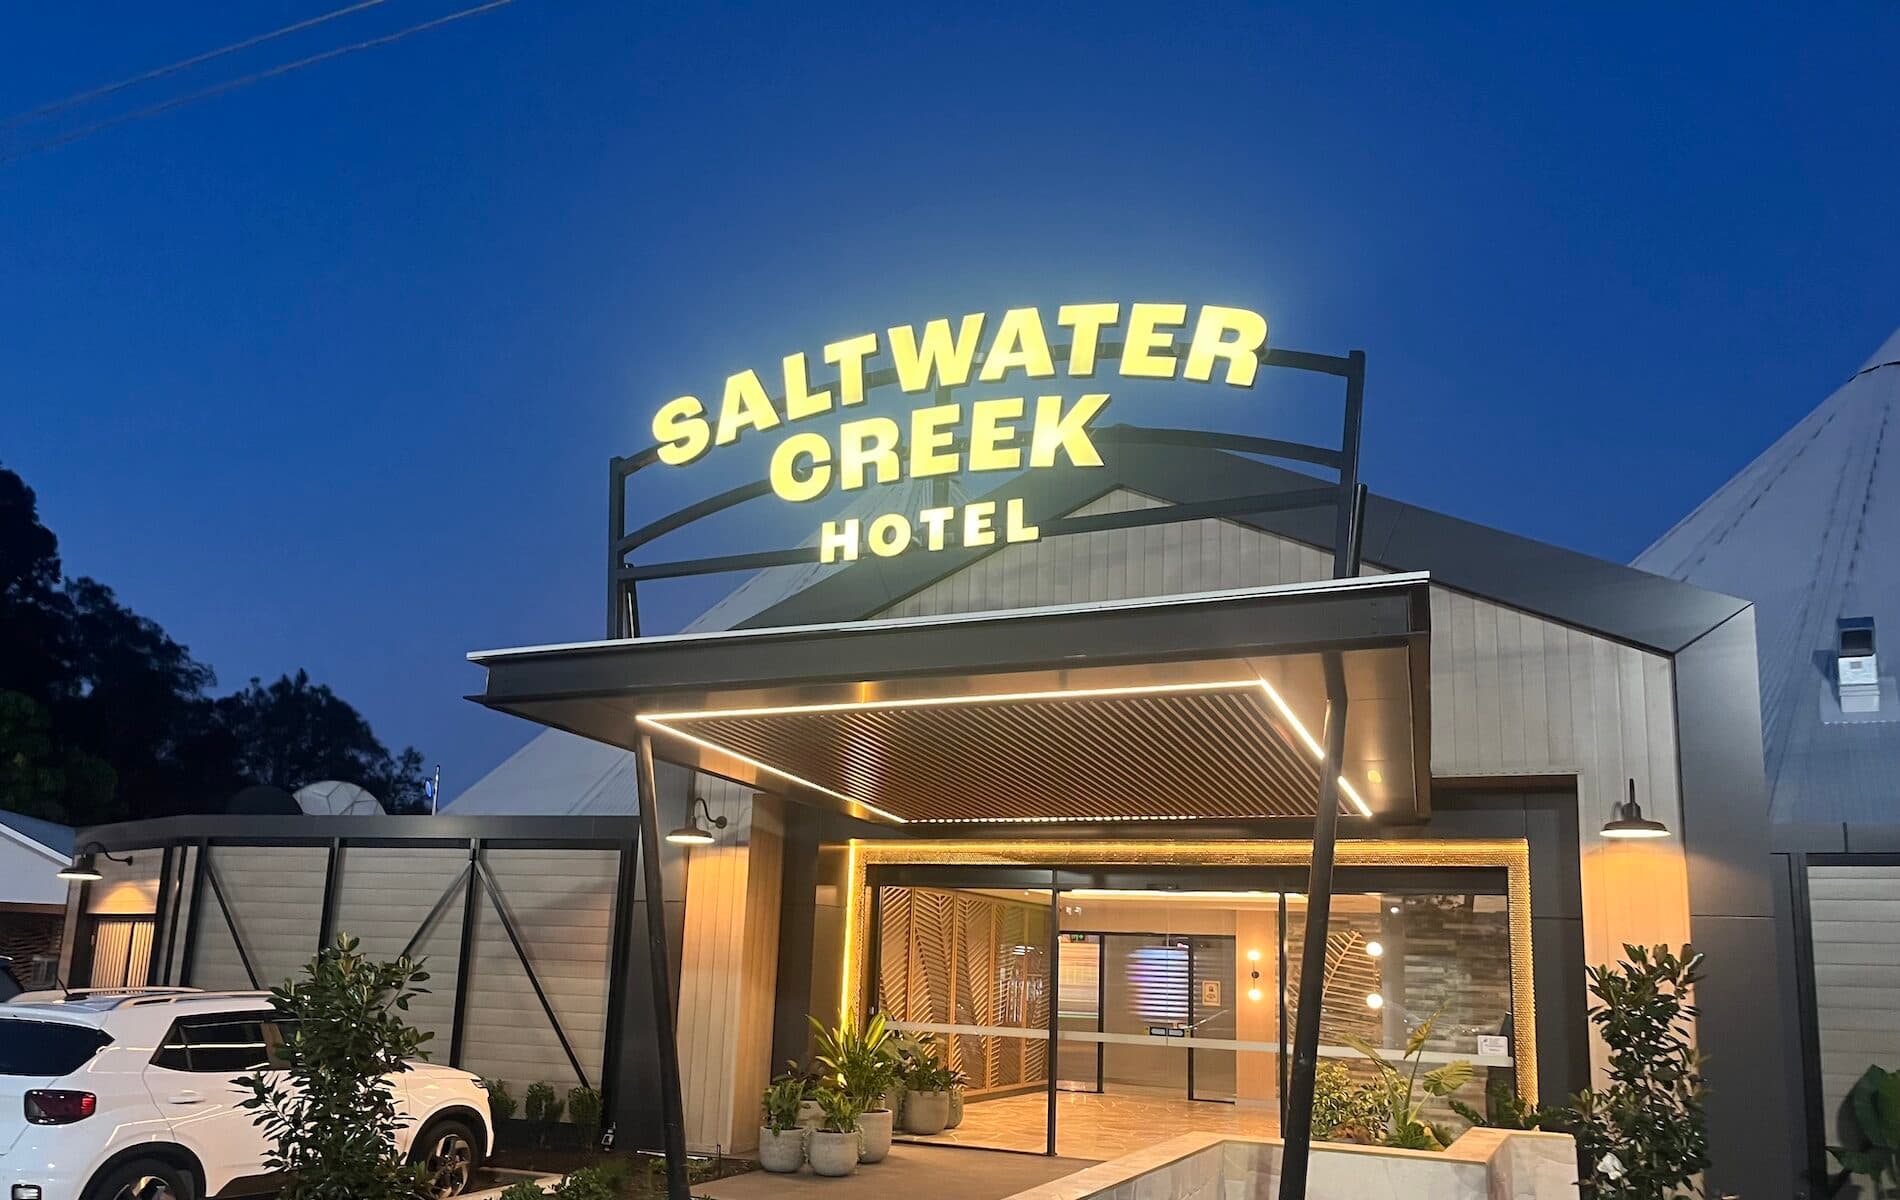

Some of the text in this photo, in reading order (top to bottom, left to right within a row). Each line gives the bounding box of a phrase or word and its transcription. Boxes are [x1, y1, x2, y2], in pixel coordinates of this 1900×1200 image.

[652, 303, 1268, 466] SALTWATER
[769, 393, 1110, 502] CREEK
[820, 498, 1039, 563] HOTEL
